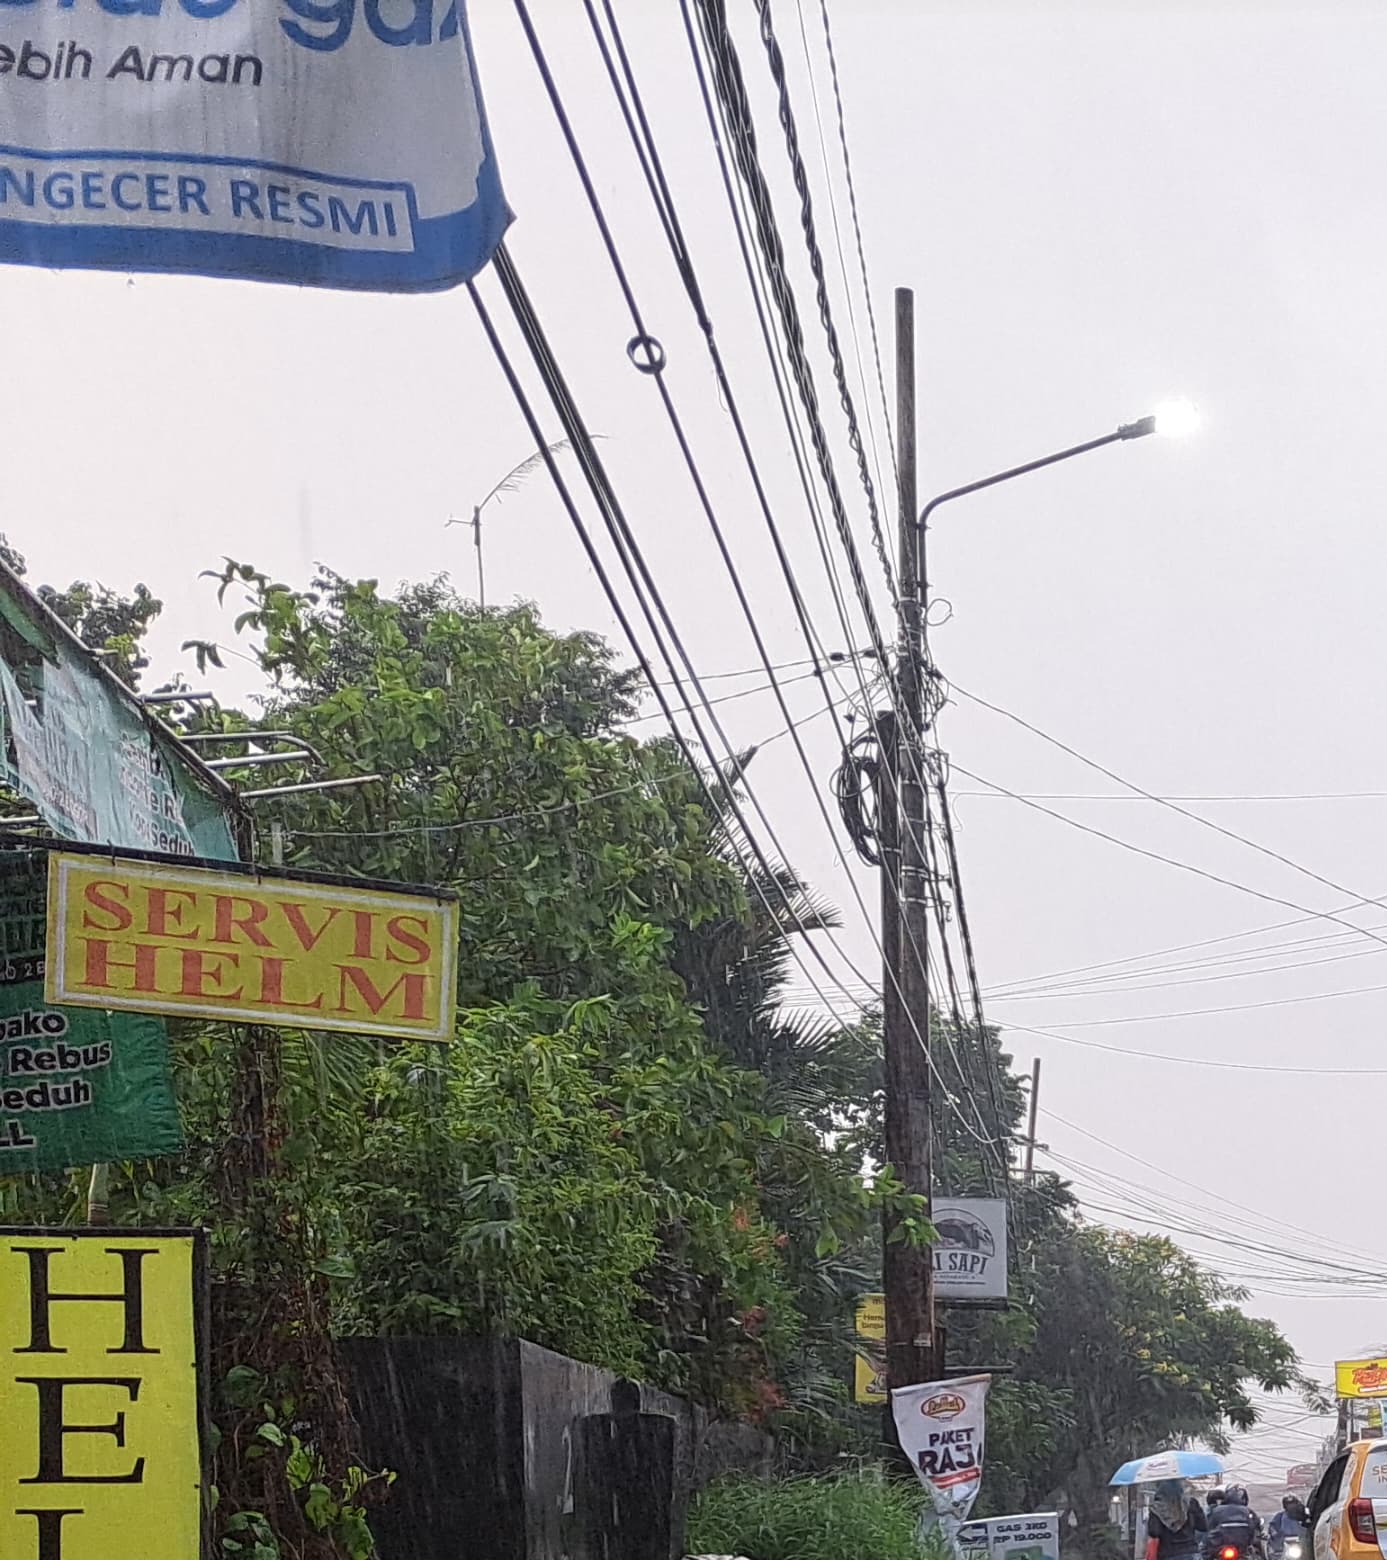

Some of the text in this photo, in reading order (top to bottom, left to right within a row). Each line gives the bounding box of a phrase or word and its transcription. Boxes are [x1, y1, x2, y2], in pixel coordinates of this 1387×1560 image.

[106, 45, 263, 86] Aman
[231, 179, 397, 238] RESMI
[82, 880, 433, 966] SERVIS
[76, 936, 434, 1021] HELM
[10, 1043, 111, 1073] Rebus
[0, 1079, 90, 1109] eduh
[0, 1121, 34, 1147] L
[949, 1253, 989, 1275] SAPI
[929, 1427, 975, 1447] PAKET
